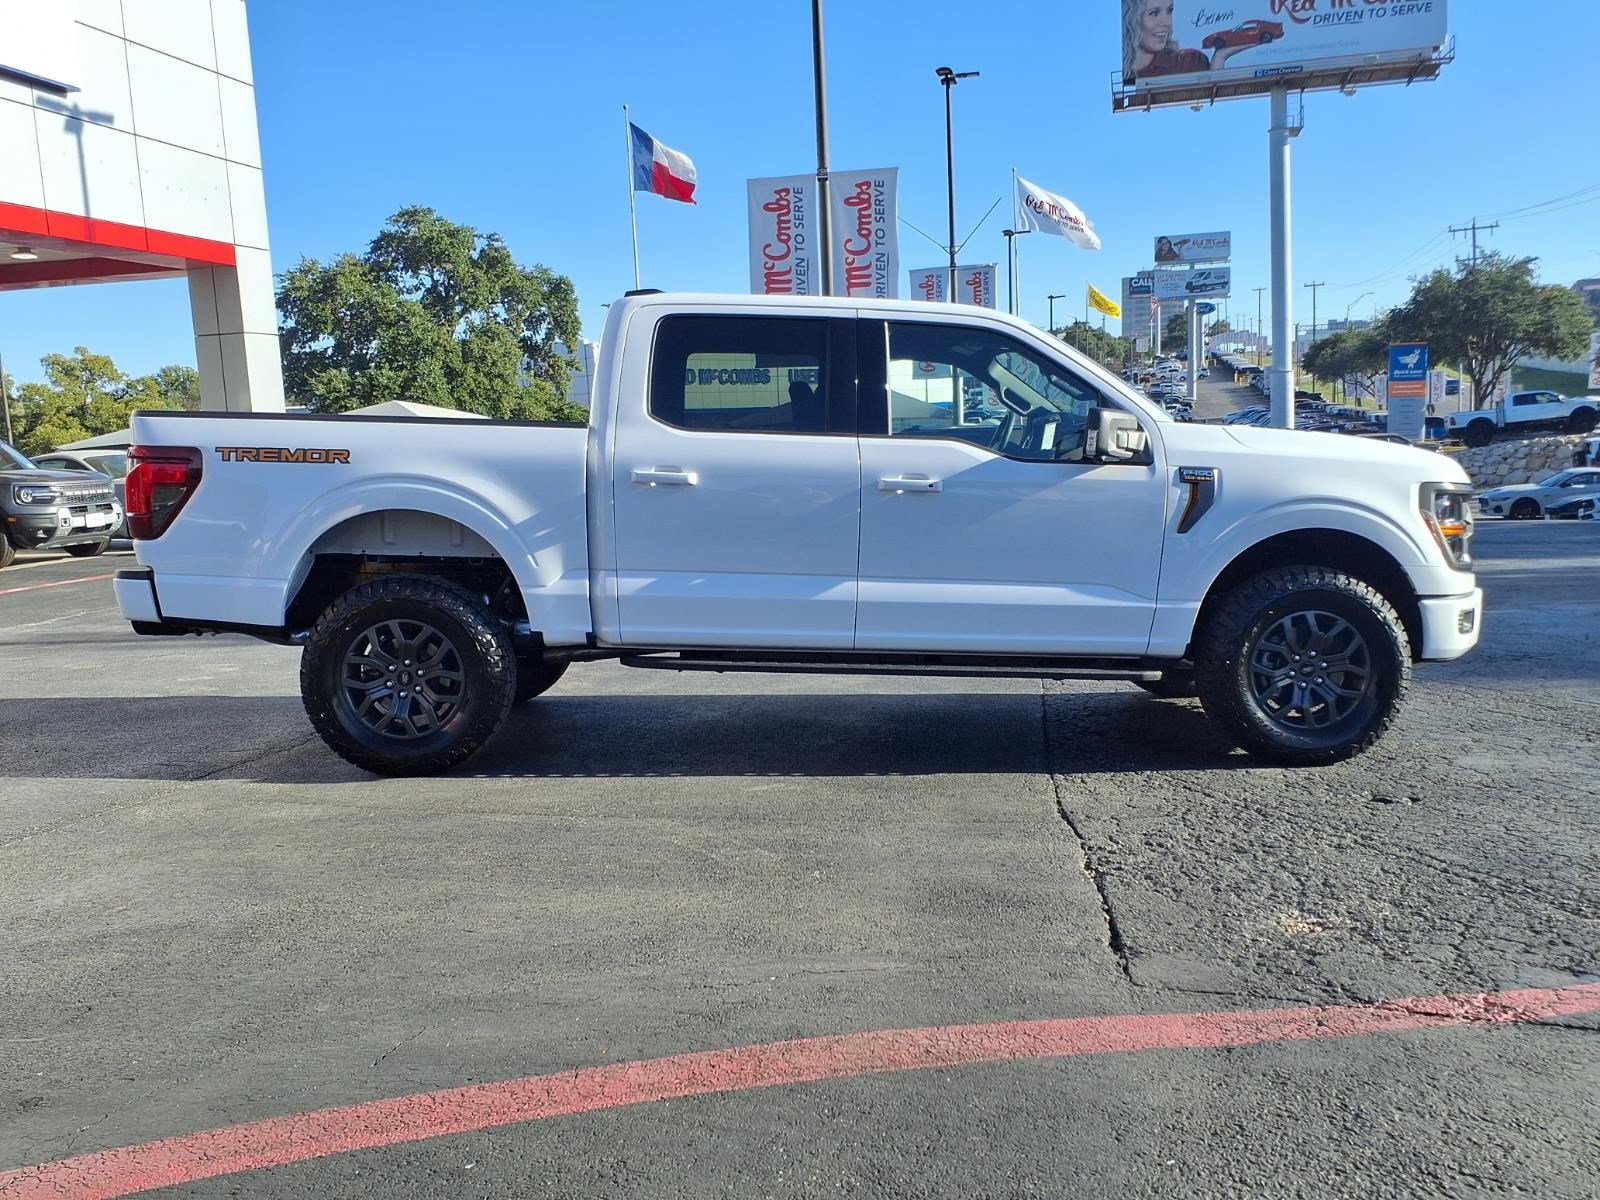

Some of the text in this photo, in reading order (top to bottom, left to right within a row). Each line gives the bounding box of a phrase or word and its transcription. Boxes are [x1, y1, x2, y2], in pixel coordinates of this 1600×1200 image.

[1312, 10, 1364, 25] DRIVEN
[1368, 8, 1387, 19] TO
[1390, 2, 1433, 17] SERVE
[793, 187, 804, 229] SERVE
[874, 180, 886, 223] SERVE
[762, 187, 793, 295] McCombs
[794, 234, 805, 253] TO
[843, 181, 872, 297] McCombs
[874, 229, 886, 247] TO
[215, 446, 351, 464] TREMOR
